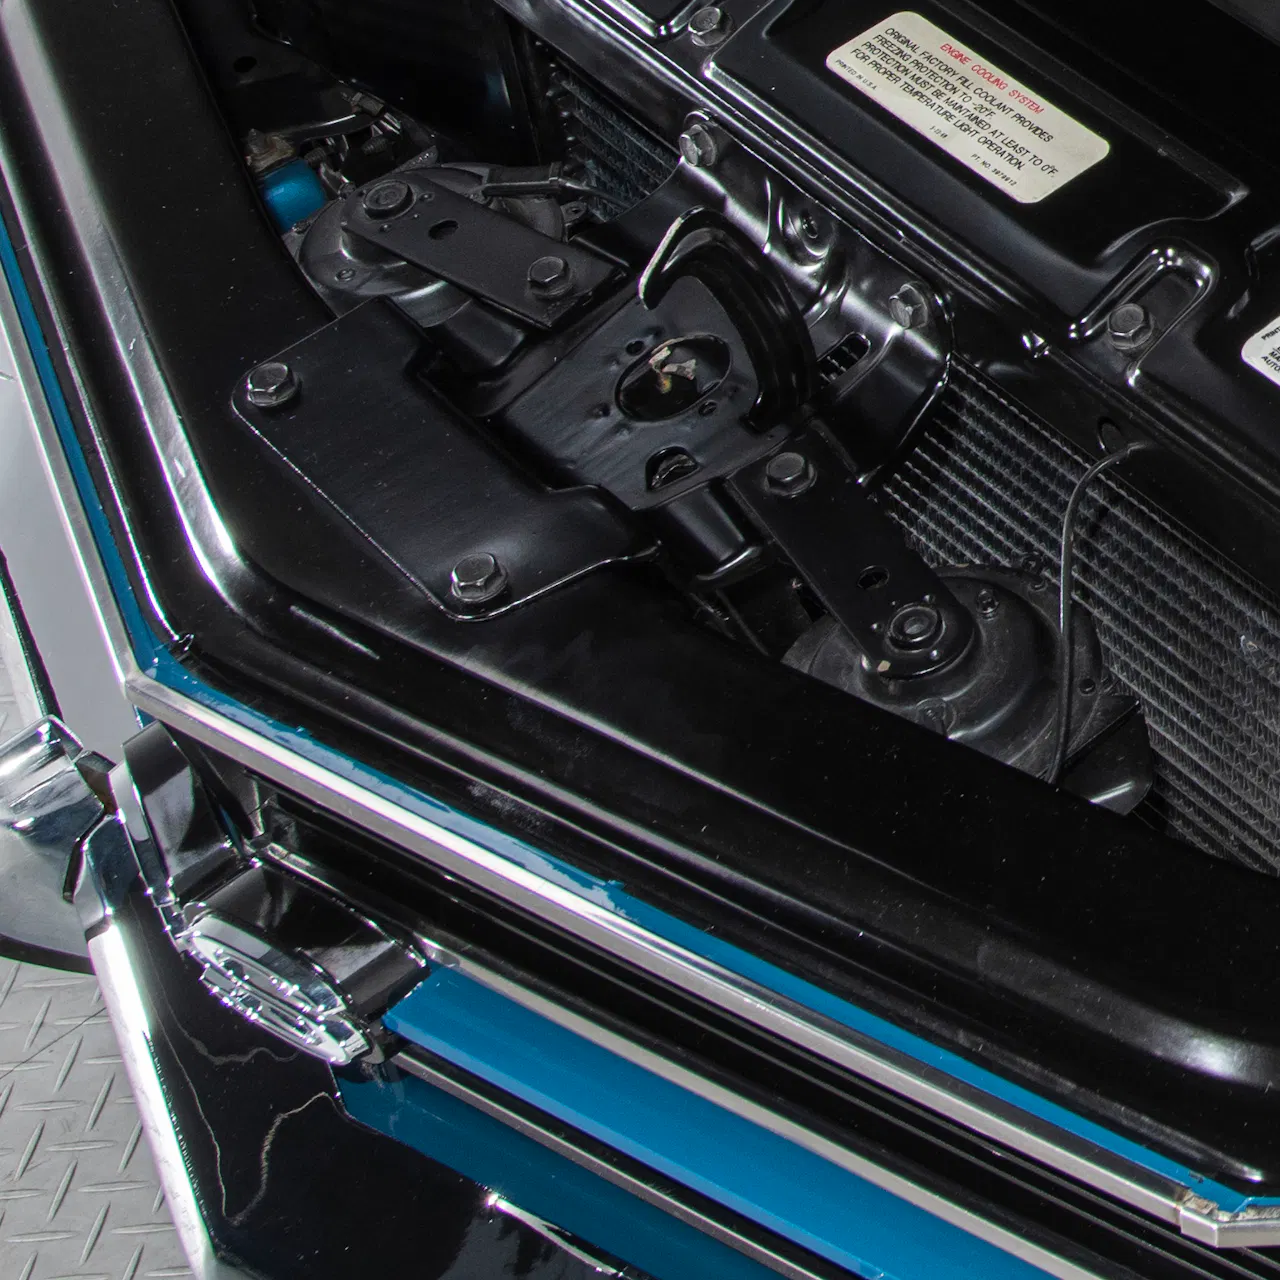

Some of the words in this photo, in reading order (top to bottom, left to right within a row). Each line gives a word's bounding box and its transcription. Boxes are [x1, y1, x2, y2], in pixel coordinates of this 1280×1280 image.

[835, 59, 857, 75] PRINTED
[850, 48, 871, 62] FOR
[867, 60, 902, 84] PROPER
[898, 81, 957, 122] TEMPERATURE
[953, 119, 980, 138] LIGHT
[976, 136, 1026, 170] OPERATION.
[861, 41, 912, 76] PROTECTION
[908, 73, 935, 91] MUST
[931, 88, 947, 100] BE
[943, 96, 992, 131] MAINTAINED
[988, 129, 1004, 139] AT
[1000, 136, 1030, 156] LEAST
[1027, 154, 1043, 166] TO
[872, 34, 912, 61] FREEZING
[908, 59, 960, 95] PROTECTION
[957, 92, 972, 103] TO
[884, 27, 921, 53] ORIGINAL
[918, 50, 959, 78] FACTORY
[955, 75, 975, 89] FILL
[972, 87, 1014, 115] COOLANT
[1010, 113, 1054, 142] PROVIDES
[939, 43, 971, 64] ENGINE
[970, 64, 1008, 90] COOLING
[1008, 89, 1045, 114] SYSTEM
